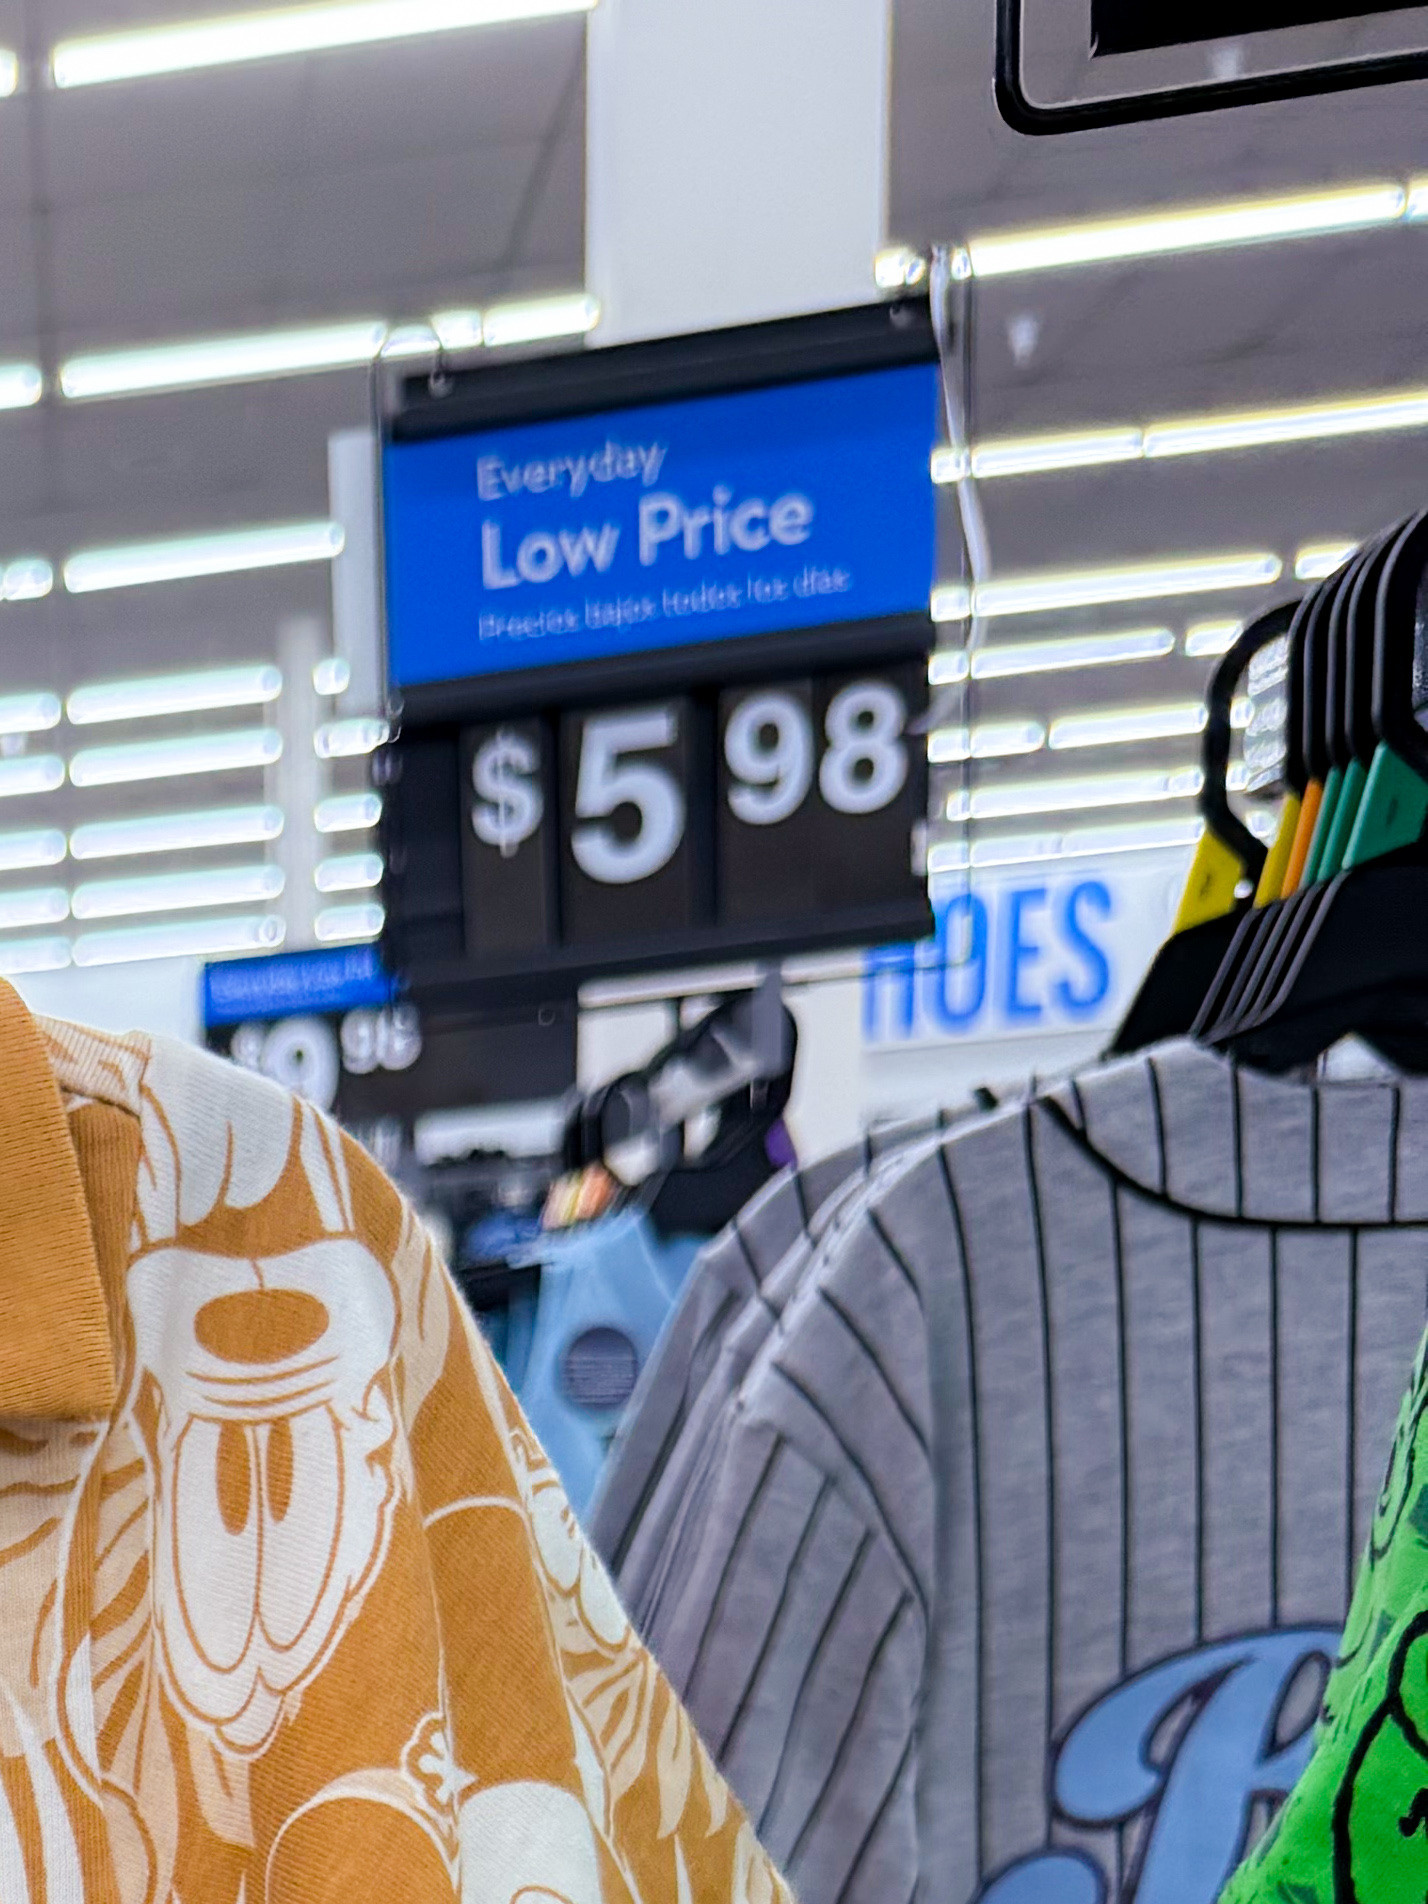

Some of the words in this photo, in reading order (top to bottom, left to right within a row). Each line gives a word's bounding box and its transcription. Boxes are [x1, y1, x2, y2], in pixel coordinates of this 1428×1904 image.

[477, 440, 667, 500] Everyday
[481, 519, 621, 590] Low
[638, 482, 815, 567] Price
